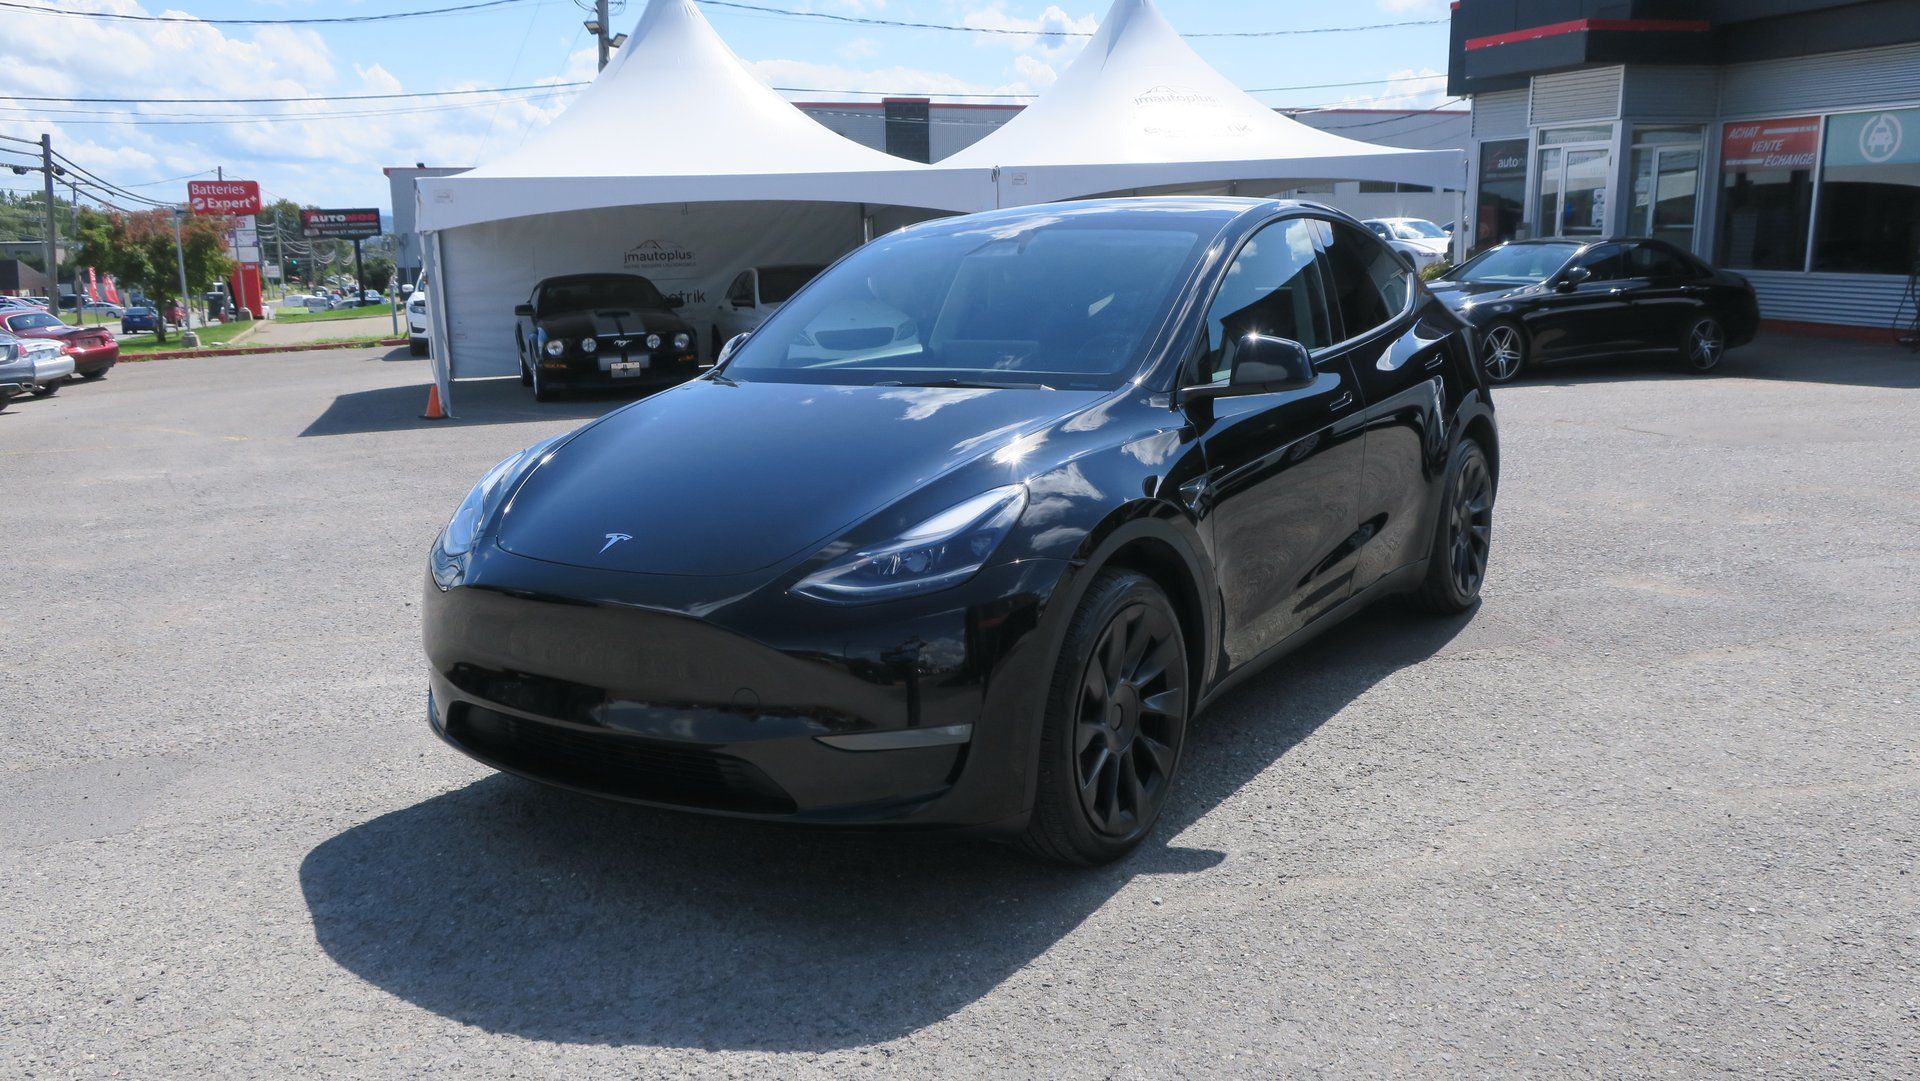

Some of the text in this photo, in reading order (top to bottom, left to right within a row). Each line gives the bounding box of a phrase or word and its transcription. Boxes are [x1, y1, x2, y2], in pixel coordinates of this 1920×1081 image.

[1728, 126, 1761, 139] ACHAT
[1751, 139, 1785, 153] VENTE
[1763, 152, 1816, 167] ÉCHANGE
[191, 184, 245, 195] Batteries
[624, 250, 693, 263] jmautoplus
